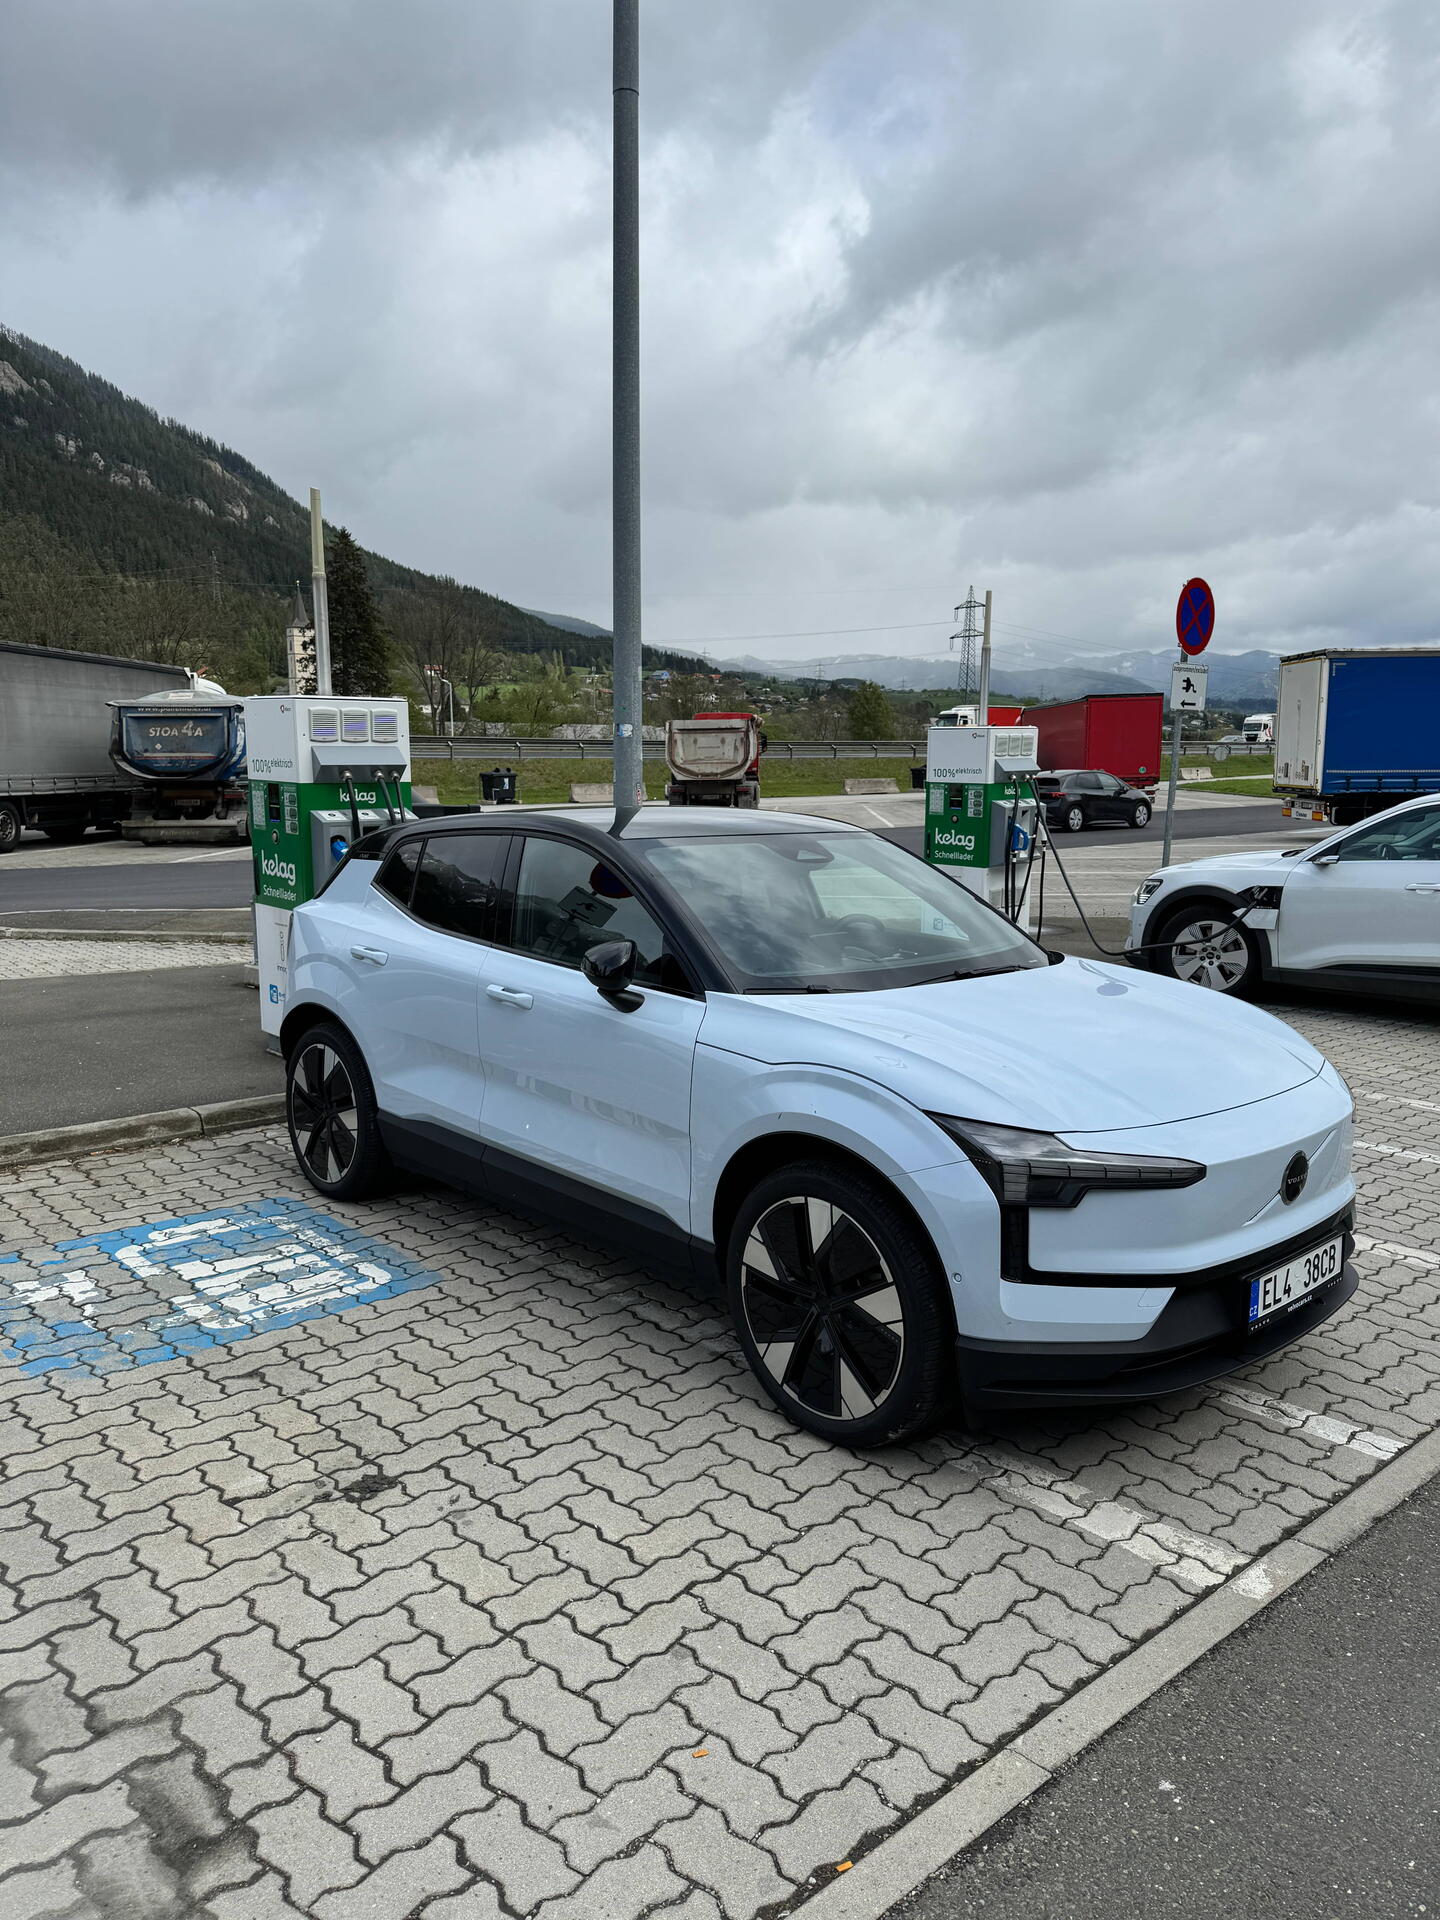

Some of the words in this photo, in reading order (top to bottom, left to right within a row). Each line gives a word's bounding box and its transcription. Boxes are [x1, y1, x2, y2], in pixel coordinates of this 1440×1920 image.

[252, 759, 271, 774] 100%
[271, 757, 294, 769] elektrisch
[933, 768, 955, 778] 100%
[955, 767, 982, 775] elektrisch
[935, 827, 975, 851] kelag
[934, 850, 974, 861] Schnelllader
[261, 849, 296, 886] kelag
[263, 884, 297, 901] Schnelllader
[1263, 1268, 1292, 1311] EL4
[1303, 1244, 1336, 1288] 38CB
[1249, 1305, 1258, 1317] CZ
